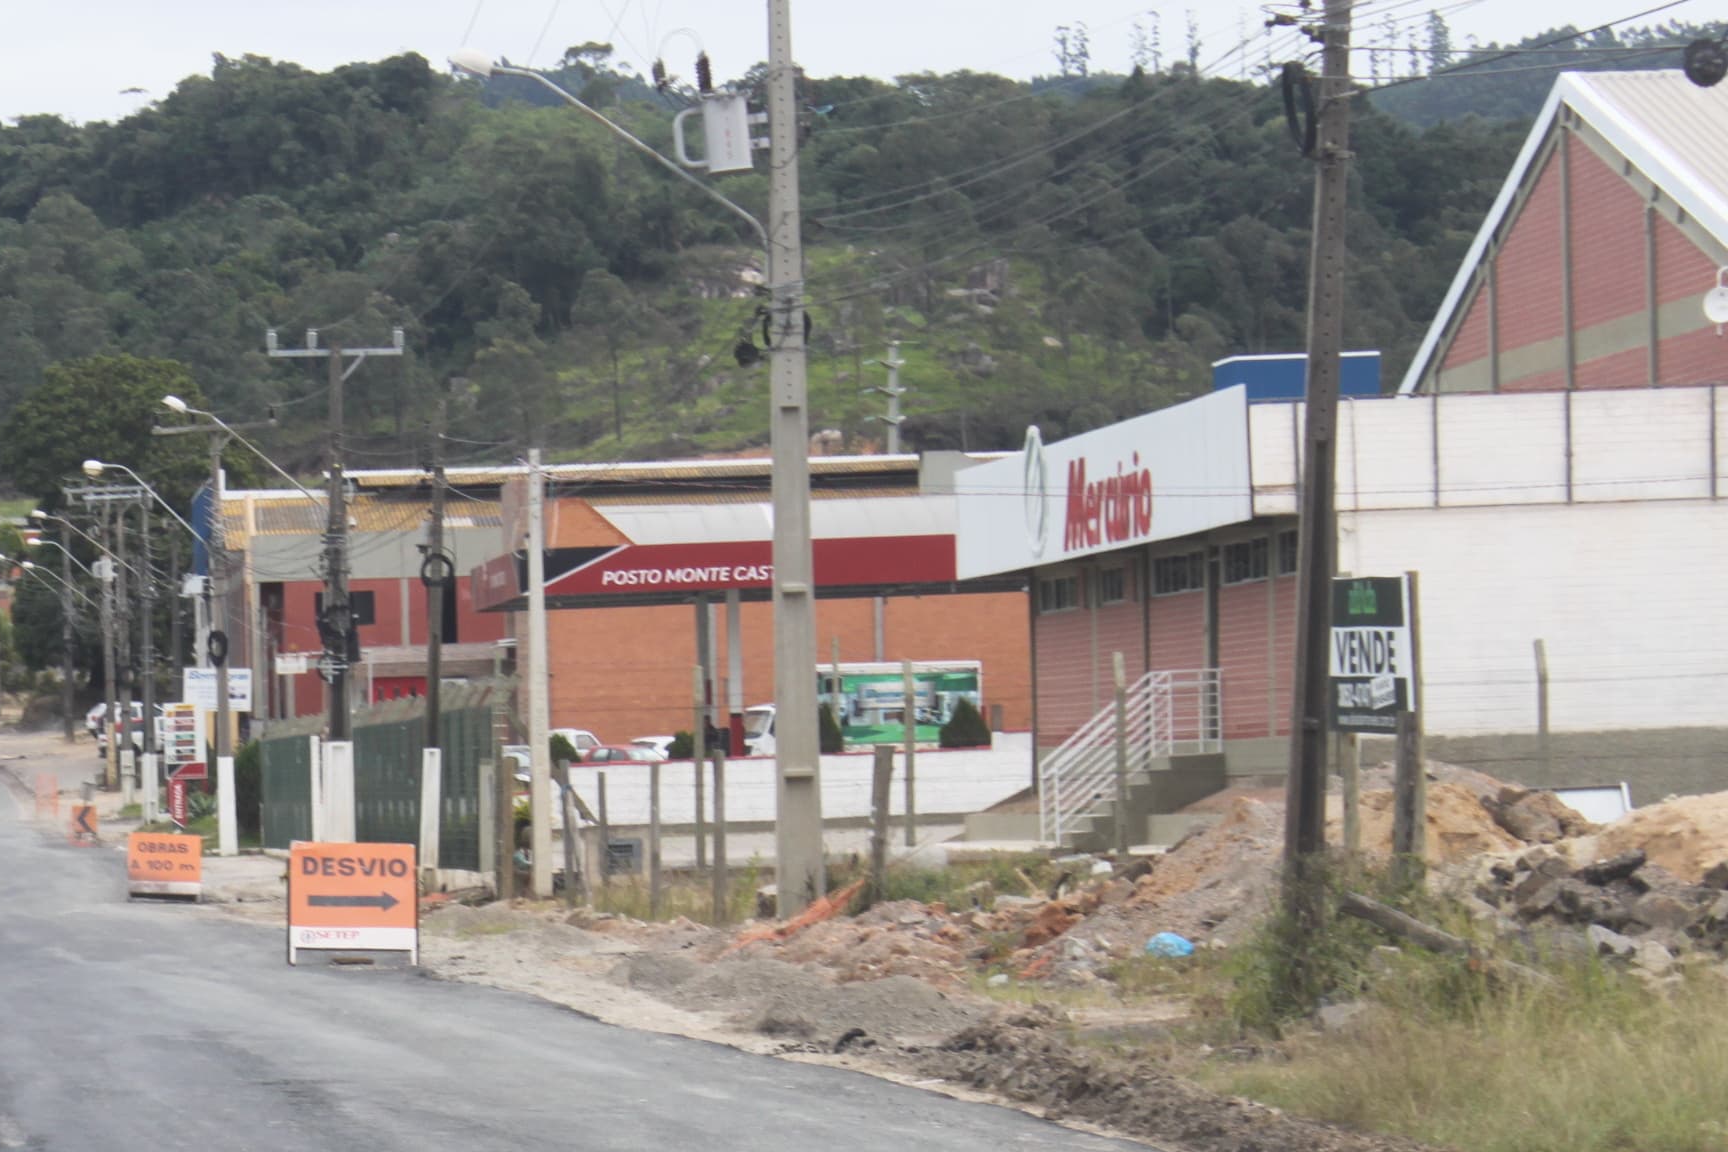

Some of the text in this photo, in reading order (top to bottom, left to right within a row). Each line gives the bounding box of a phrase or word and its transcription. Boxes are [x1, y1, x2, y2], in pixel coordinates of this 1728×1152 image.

[602, 568, 662, 586] POSTO
[665, 566, 731, 583] MONTE
[1335, 631, 1396, 674] VENDE
[174, 784, 184, 819] ENTRADA
[137, 842, 189, 854] OBRAS
[147, 860, 174, 872] 100
[302, 856, 409, 877] DESVIO
